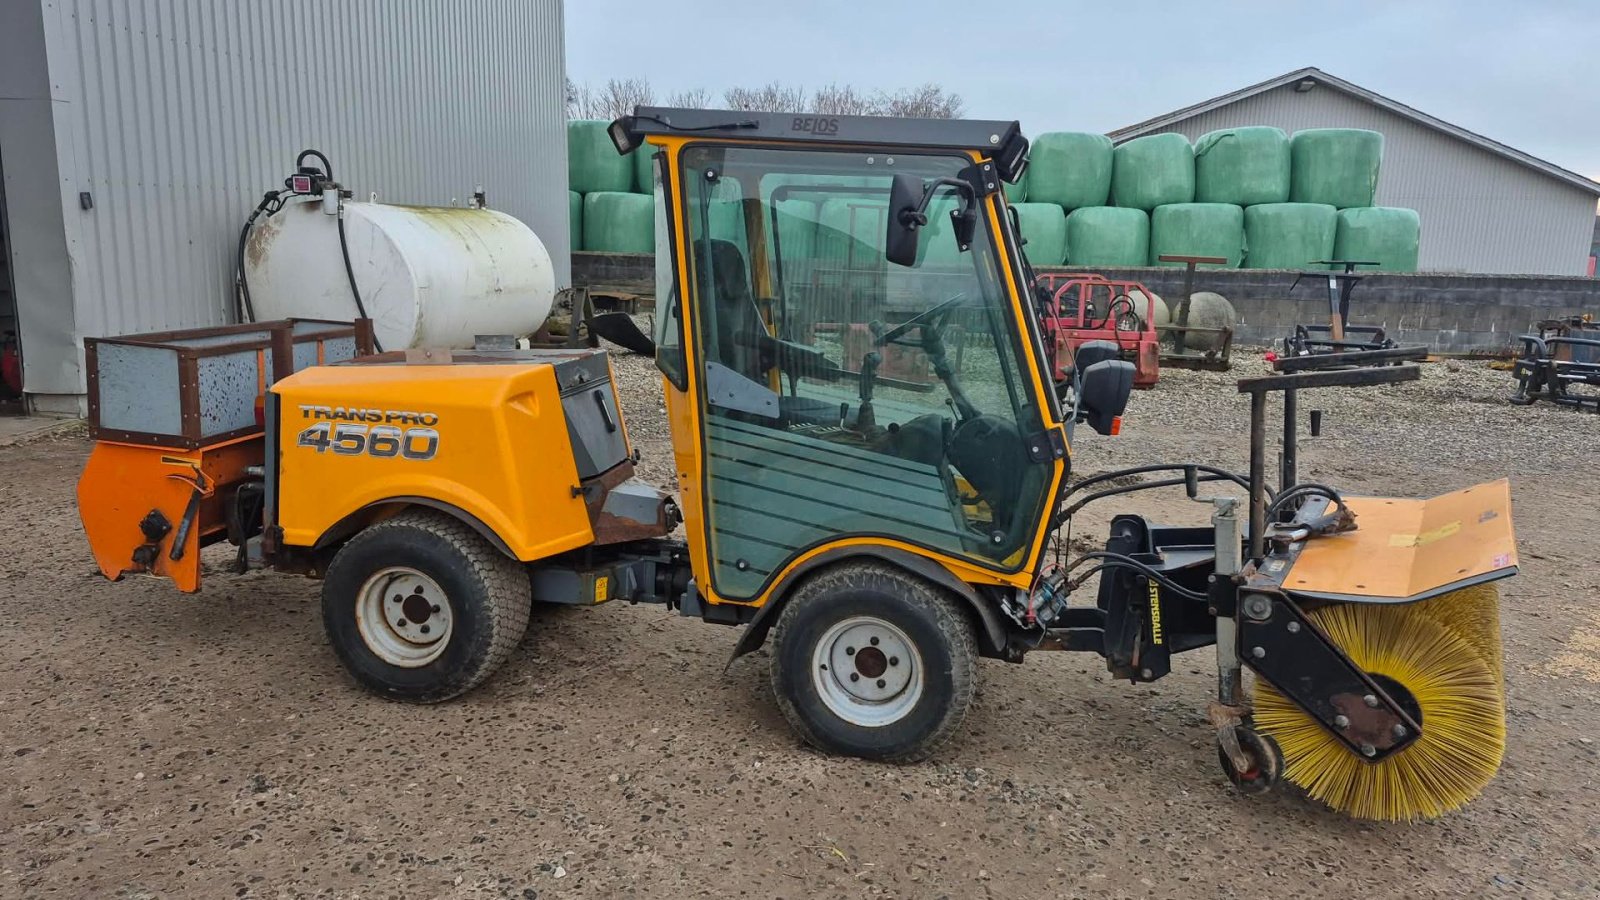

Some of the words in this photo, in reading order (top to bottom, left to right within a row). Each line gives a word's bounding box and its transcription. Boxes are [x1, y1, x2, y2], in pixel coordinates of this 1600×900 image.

[791, 117, 839, 136] BELOS
[297, 422, 439, 460] 4560
[1149, 587, 1162, 645] STENSBALLE
